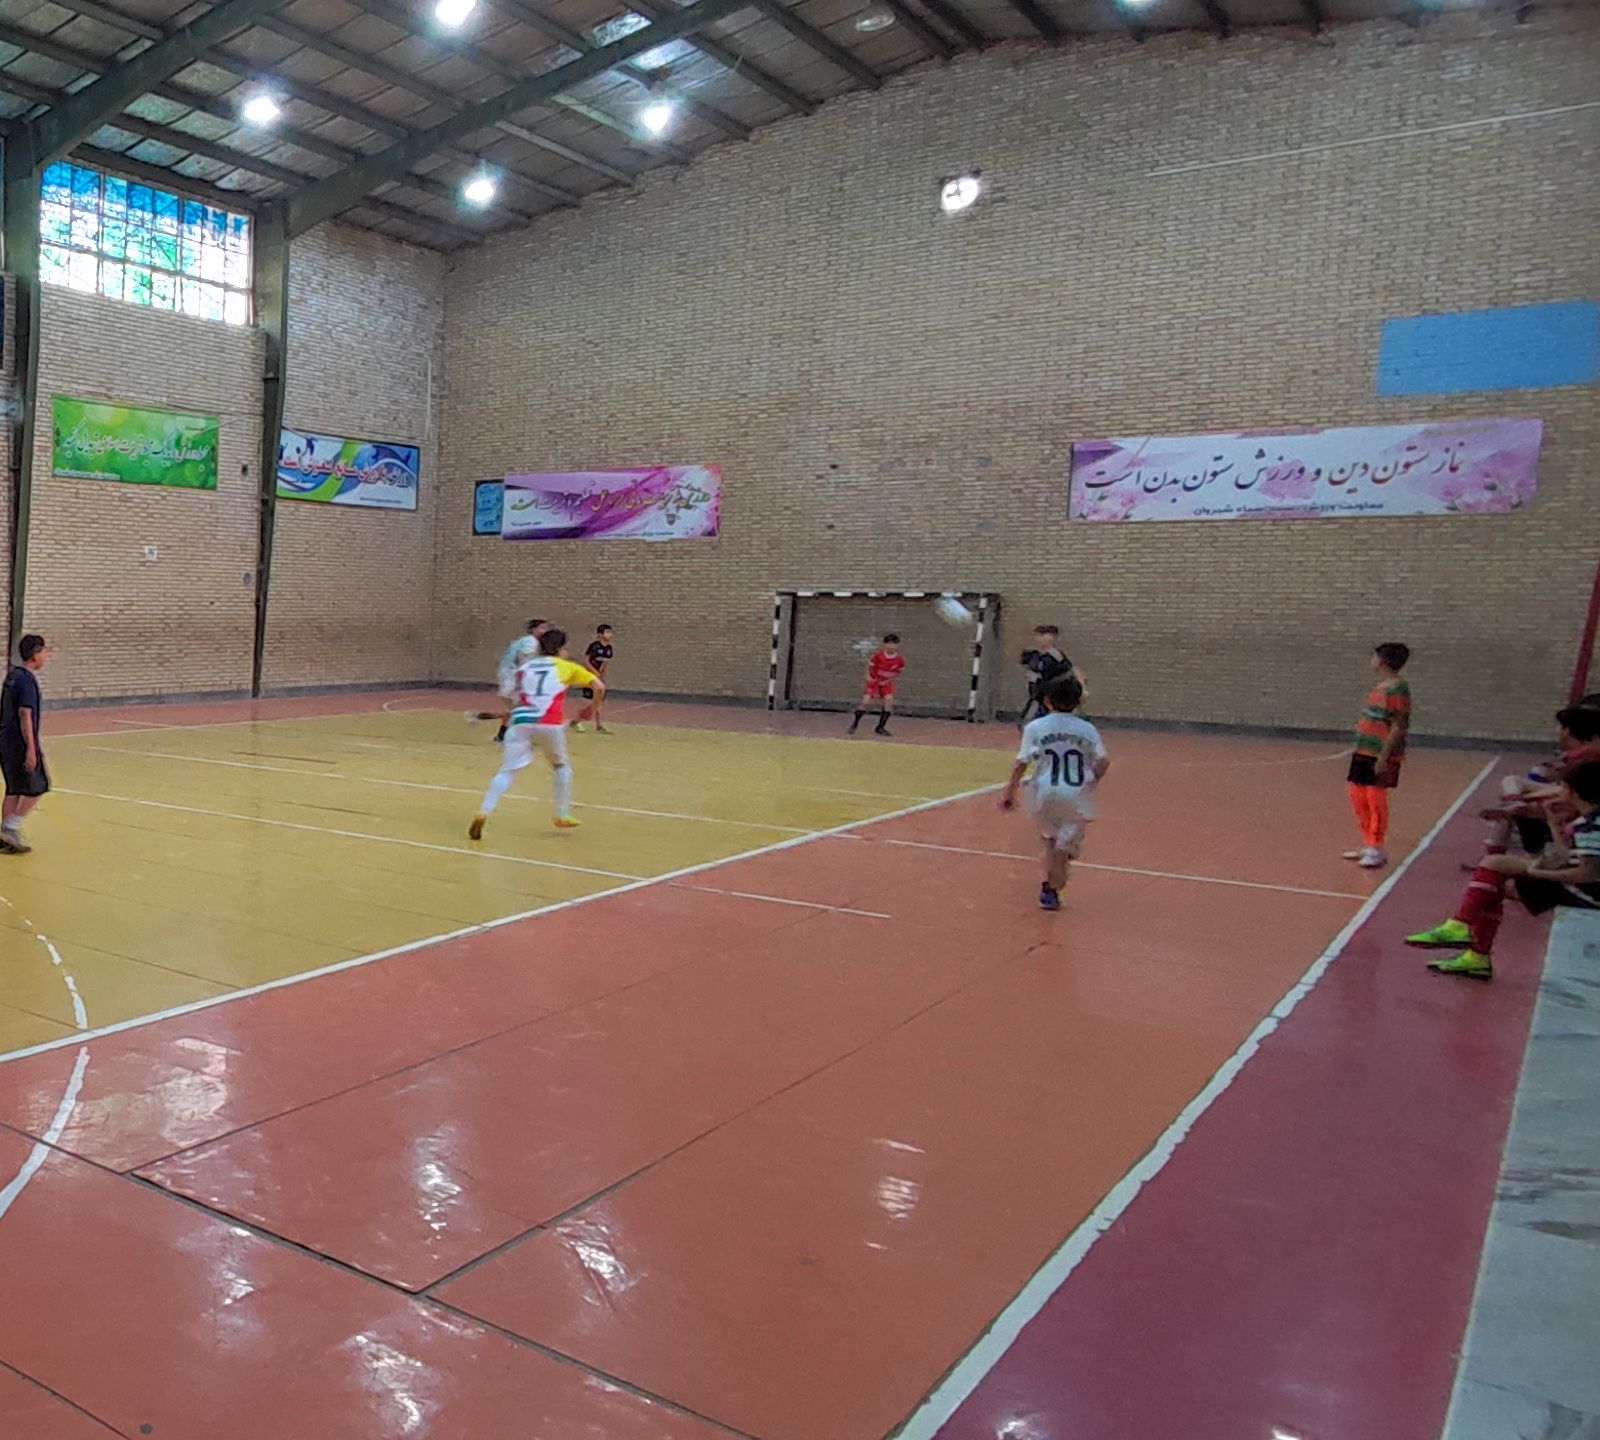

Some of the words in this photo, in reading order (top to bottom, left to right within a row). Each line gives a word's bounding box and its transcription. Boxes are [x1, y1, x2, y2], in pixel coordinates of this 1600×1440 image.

[1183, 455, 1235, 492] ستون
[1234, 448, 1306, 490] ورزش
[1310, 467, 1322, 482] و
[1371, 445, 1430, 485] ستون
[1431, 441, 1466, 475] نماز
[1085, 470, 1142, 488] است
[1143, 471, 1180, 503] بدن
[1328, 461, 1370, 494] دین
[1193, 504, 1234, 516] شیروان
[534, 670, 549, 697] 7
[1044, 748, 1085, 787] 10
